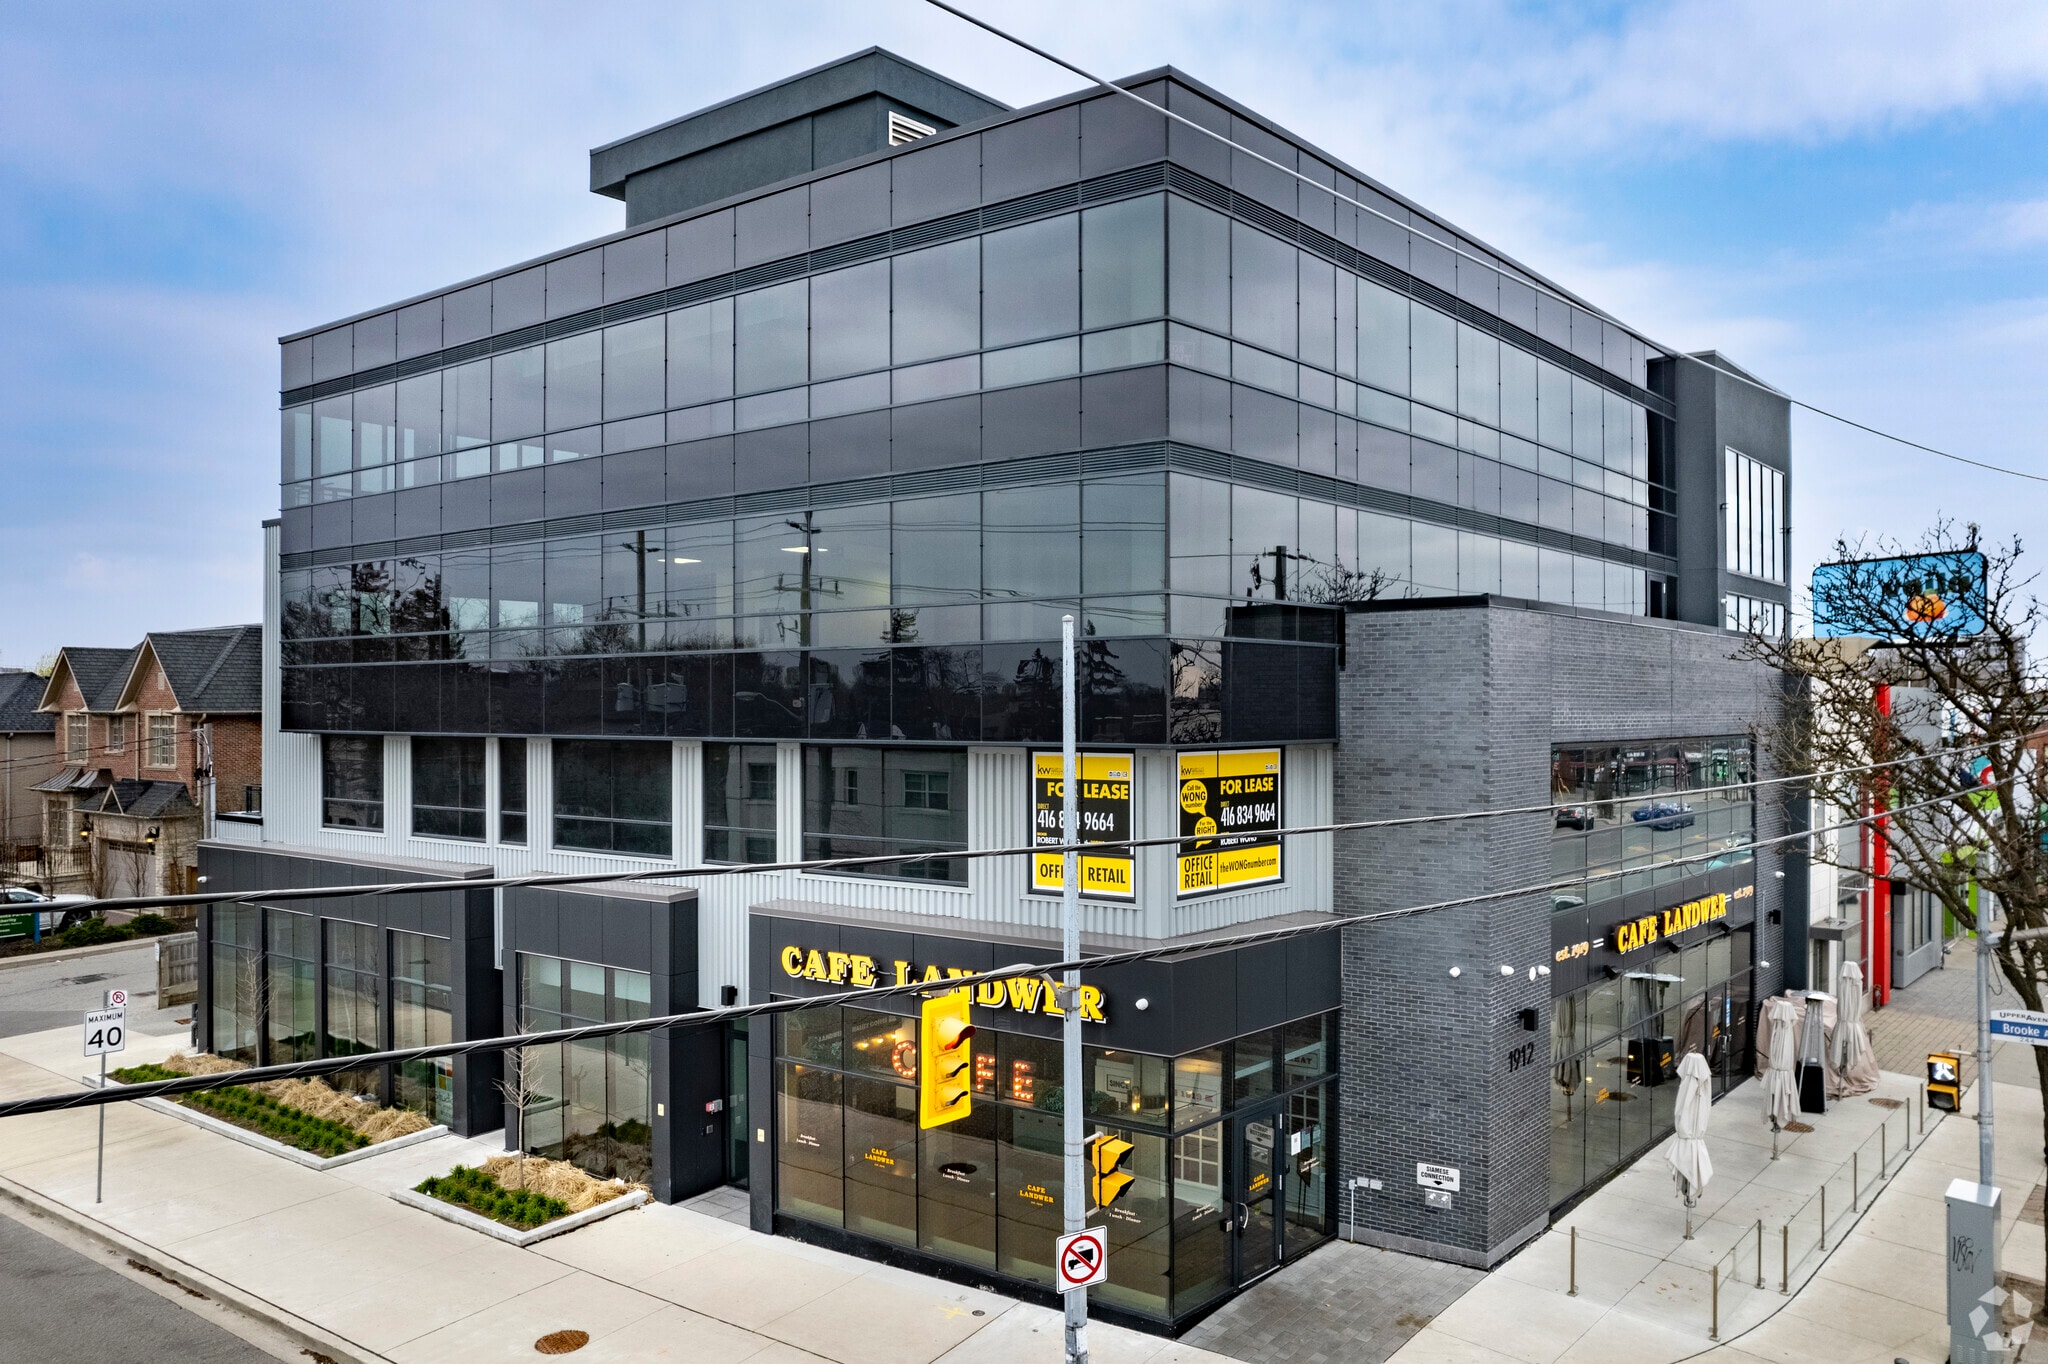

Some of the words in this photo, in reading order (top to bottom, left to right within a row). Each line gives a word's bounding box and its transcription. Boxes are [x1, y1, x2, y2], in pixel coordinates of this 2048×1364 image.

[1047, 782, 1079, 798] FO
[1083, 783, 1129, 800] LEASE
[1220, 779, 1242, 795] FOR
[1244, 776, 1274, 793] LEASE
[1182, 791, 1206, 802] WONG
[1037, 810, 1056, 828] 416
[1084, 811, 1114, 832] 9664
[1220, 806, 1235, 827] 416
[1236, 804, 1253, 825] 834
[1254, 802, 1275, 823] 9664
[1196, 825, 1215, 835] RIGHT
[1036, 836, 1059, 845] ROBERT
[1040, 863, 1064, 879] OFFI
[1184, 855, 1213, 873] OFFICE
[1088, 867, 1126, 884] RETAIL
[1184, 870, 1213, 889] RETAIL
[1617, 915, 1658, 954] CAFE
[1662, 893, 1727, 938] LANDWER
[781, 945, 877, 989] CAFE
[88, 1012, 123, 1023] MAXIMUM
[87, 1026, 123, 1049] 40
[2003, 1023, 2040, 1037] Brooke
[1508, 1041, 1535, 1073] 1912
[864, 1152, 895, 1166] LANDWER
[871, 1147, 888, 1157] CAFE
[1420, 1171, 1454, 1182] CONNECTION
[1426, 1165, 1449, 1176] SIAMESE
[1019, 1189, 1055, 1204] LANDWER
[1027, 1184, 1046, 1194] CAFE
[1114, 1207, 1136, 1217] Breakfast
